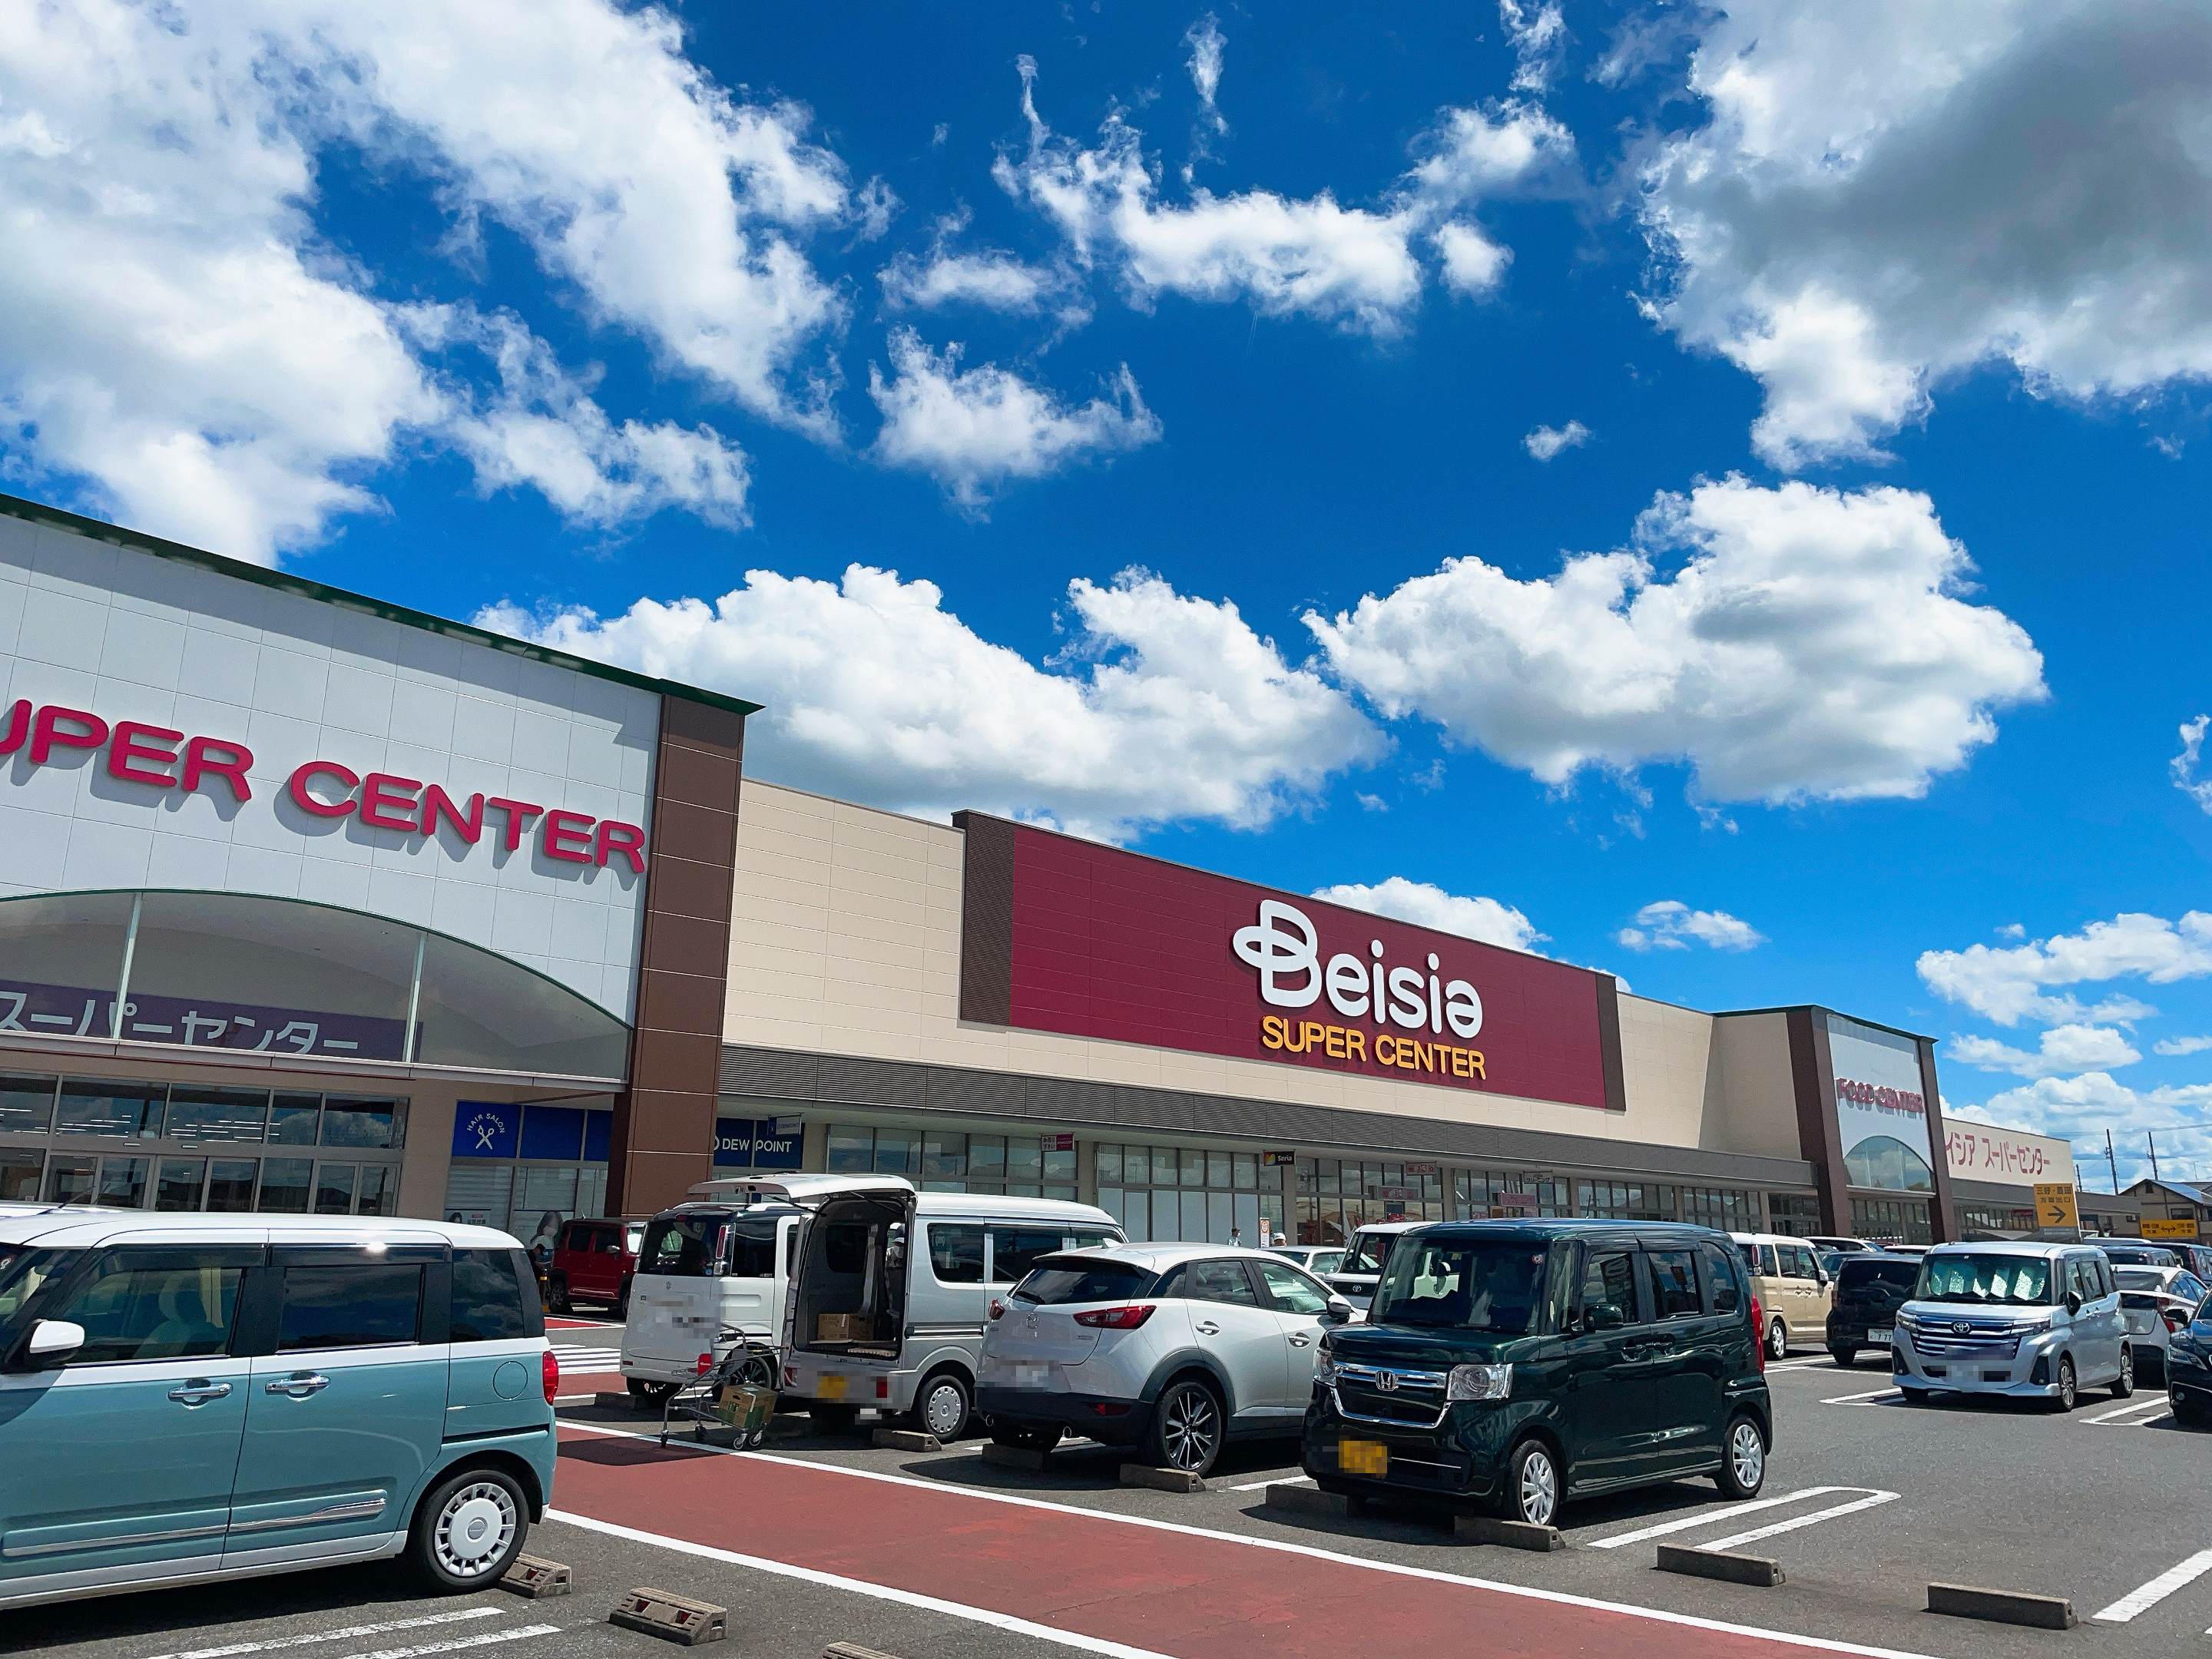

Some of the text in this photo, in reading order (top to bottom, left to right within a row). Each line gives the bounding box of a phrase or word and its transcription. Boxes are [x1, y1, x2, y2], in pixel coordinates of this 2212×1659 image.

[290, 760, 646, 874] CENTER
[1233, 899, 1483, 1038] Beisia
[1263, 1015, 1487, 1081] SUPER CENTER
[1836, 1078, 1875, 1104] FOOD
[466, 1113, 505, 1134] HAIR SALON
[722, 1137, 793, 1153] DEW POINT
[1981, 1137, 2051, 1175] スーパーセンター
